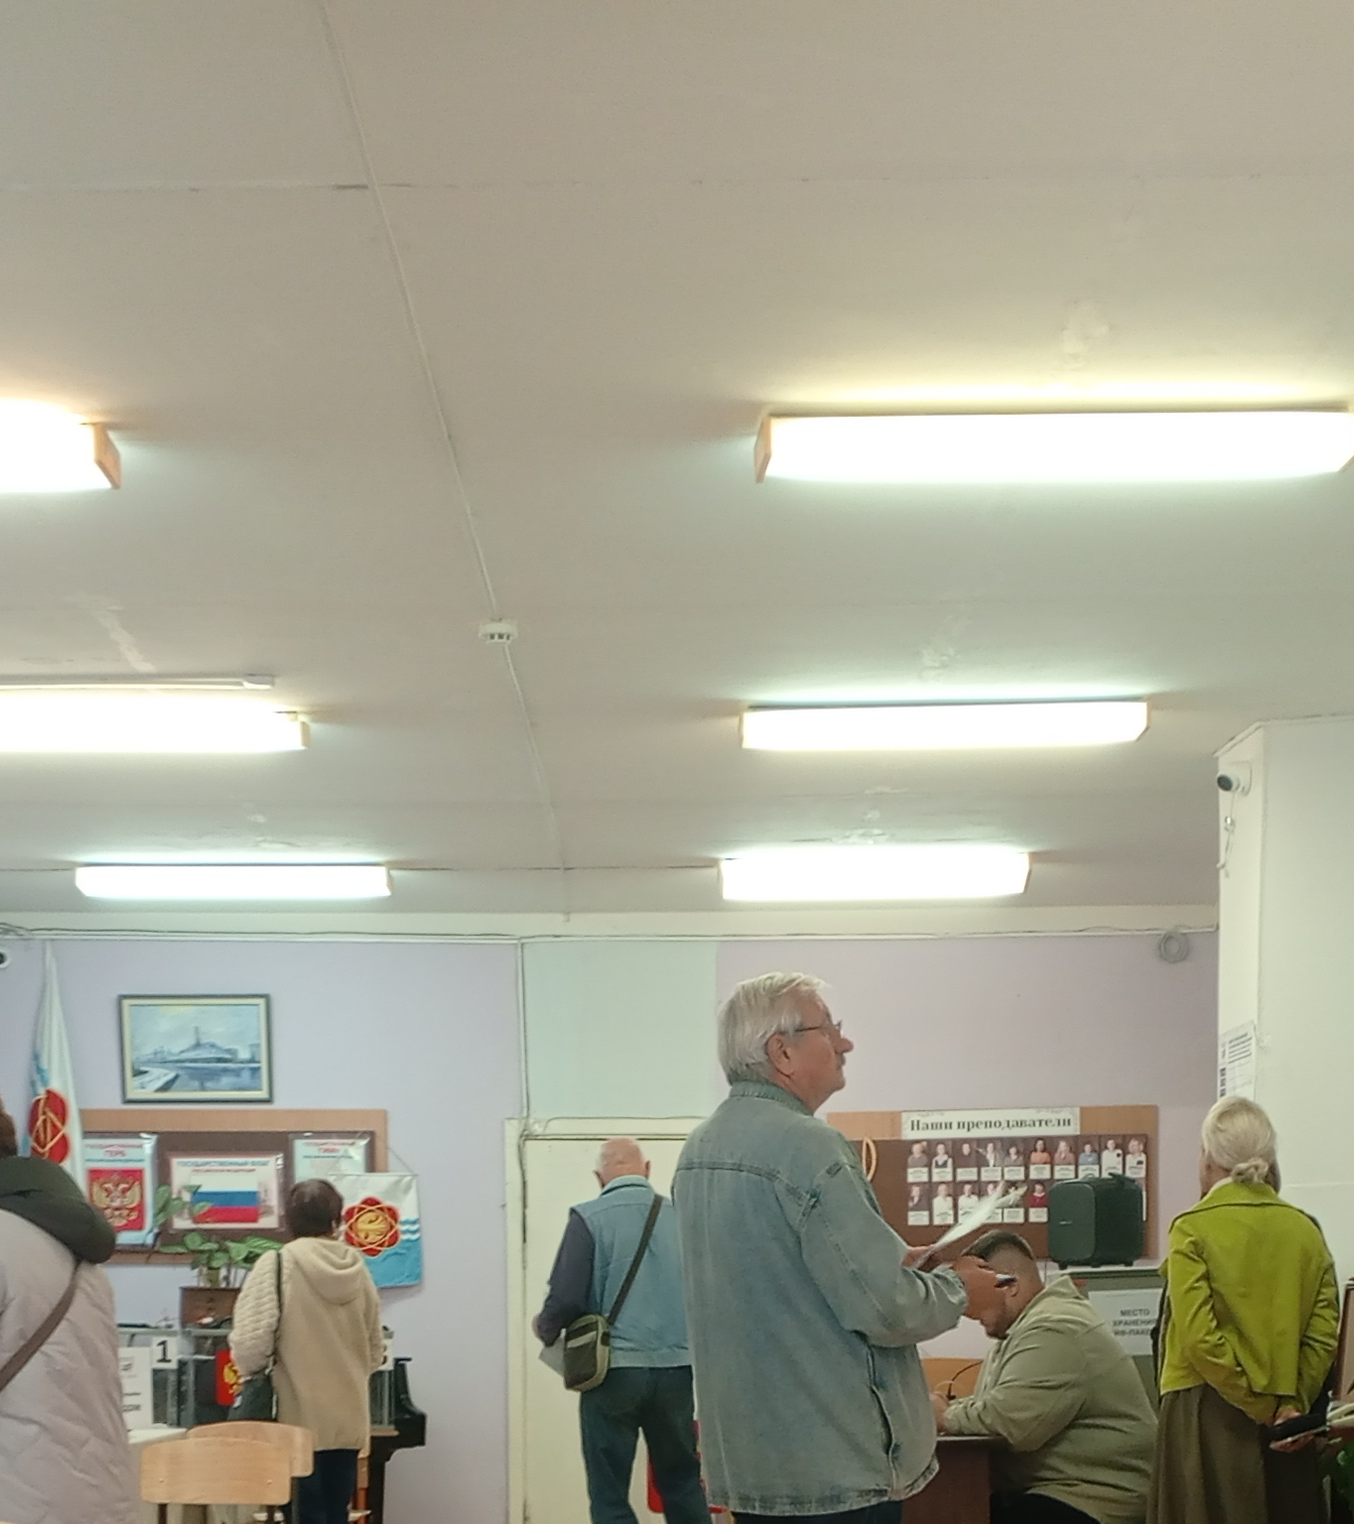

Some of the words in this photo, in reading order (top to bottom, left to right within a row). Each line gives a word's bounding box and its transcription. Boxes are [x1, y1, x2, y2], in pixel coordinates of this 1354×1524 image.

[910, 1119, 953, 1132] Наши
[957, 1117, 1071, 1132] преподаватели
[1120, 1308, 1150, 1317] МЕСТО
[156, 1340, 172, 1363] 1
